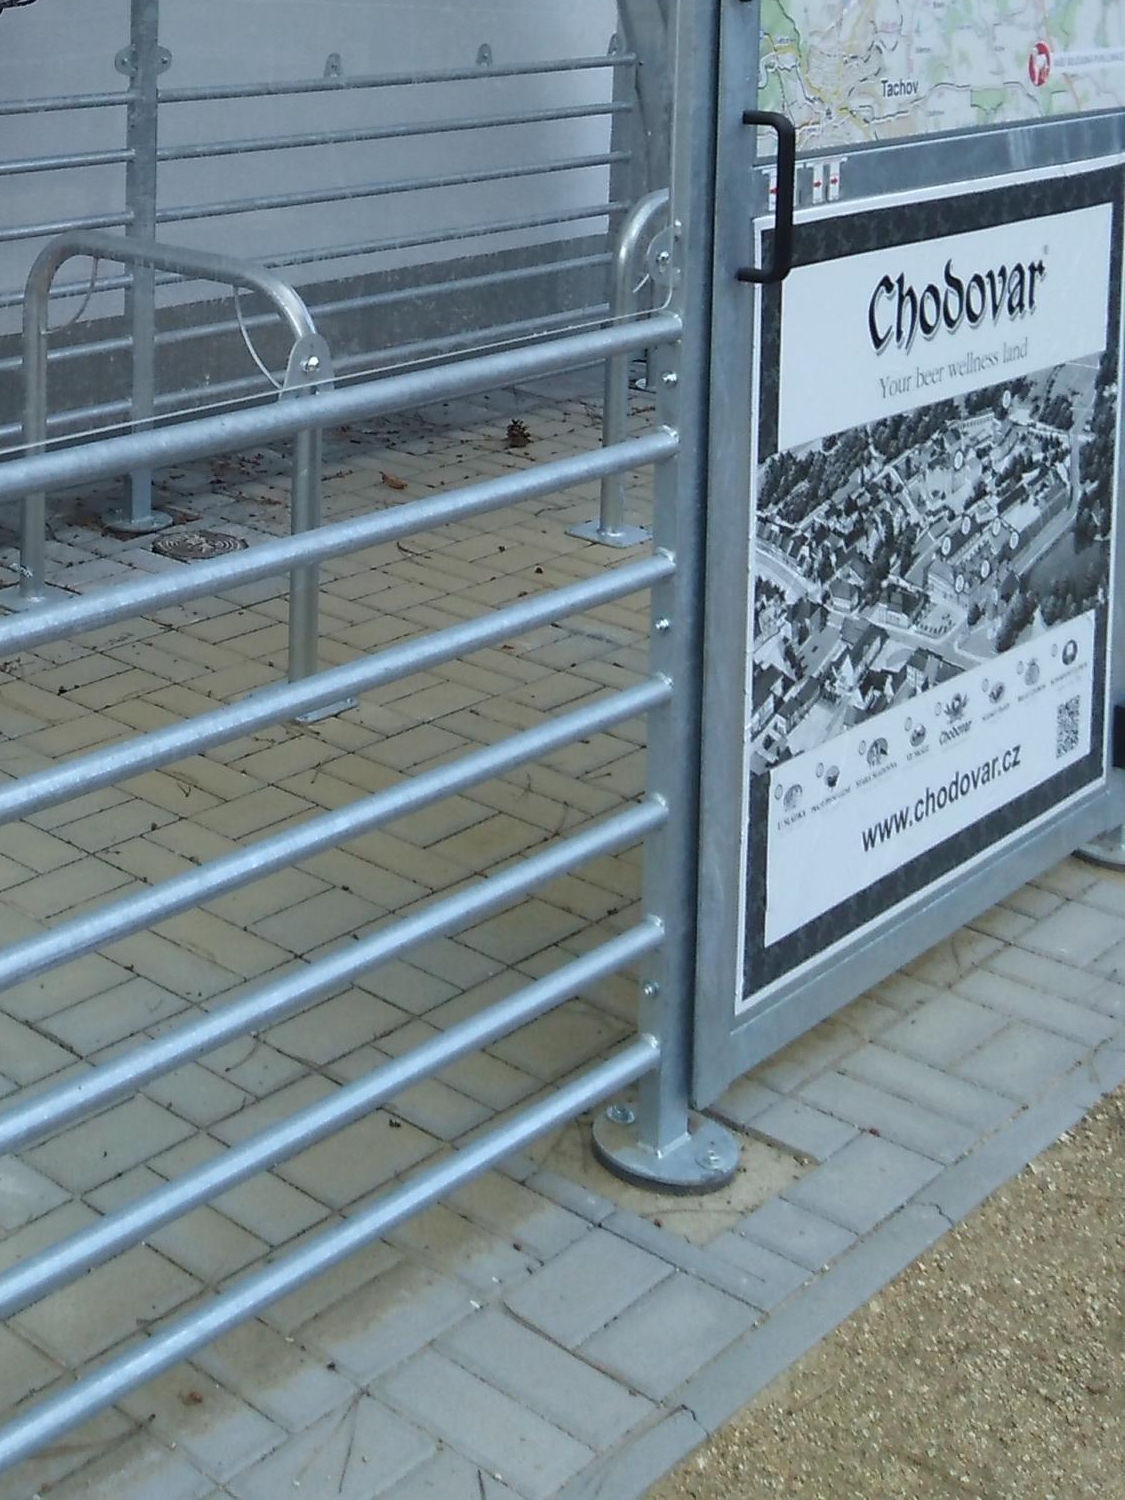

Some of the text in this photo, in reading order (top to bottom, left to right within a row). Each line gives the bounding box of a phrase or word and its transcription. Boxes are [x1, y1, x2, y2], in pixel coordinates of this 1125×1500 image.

[881, 78, 919, 100] Tachov
[868, 258, 1046, 356] Chodovar
[879, 337, 1029, 399] Your beer wellness land
[860, 744, 1022, 853] www.chodovar.cz
